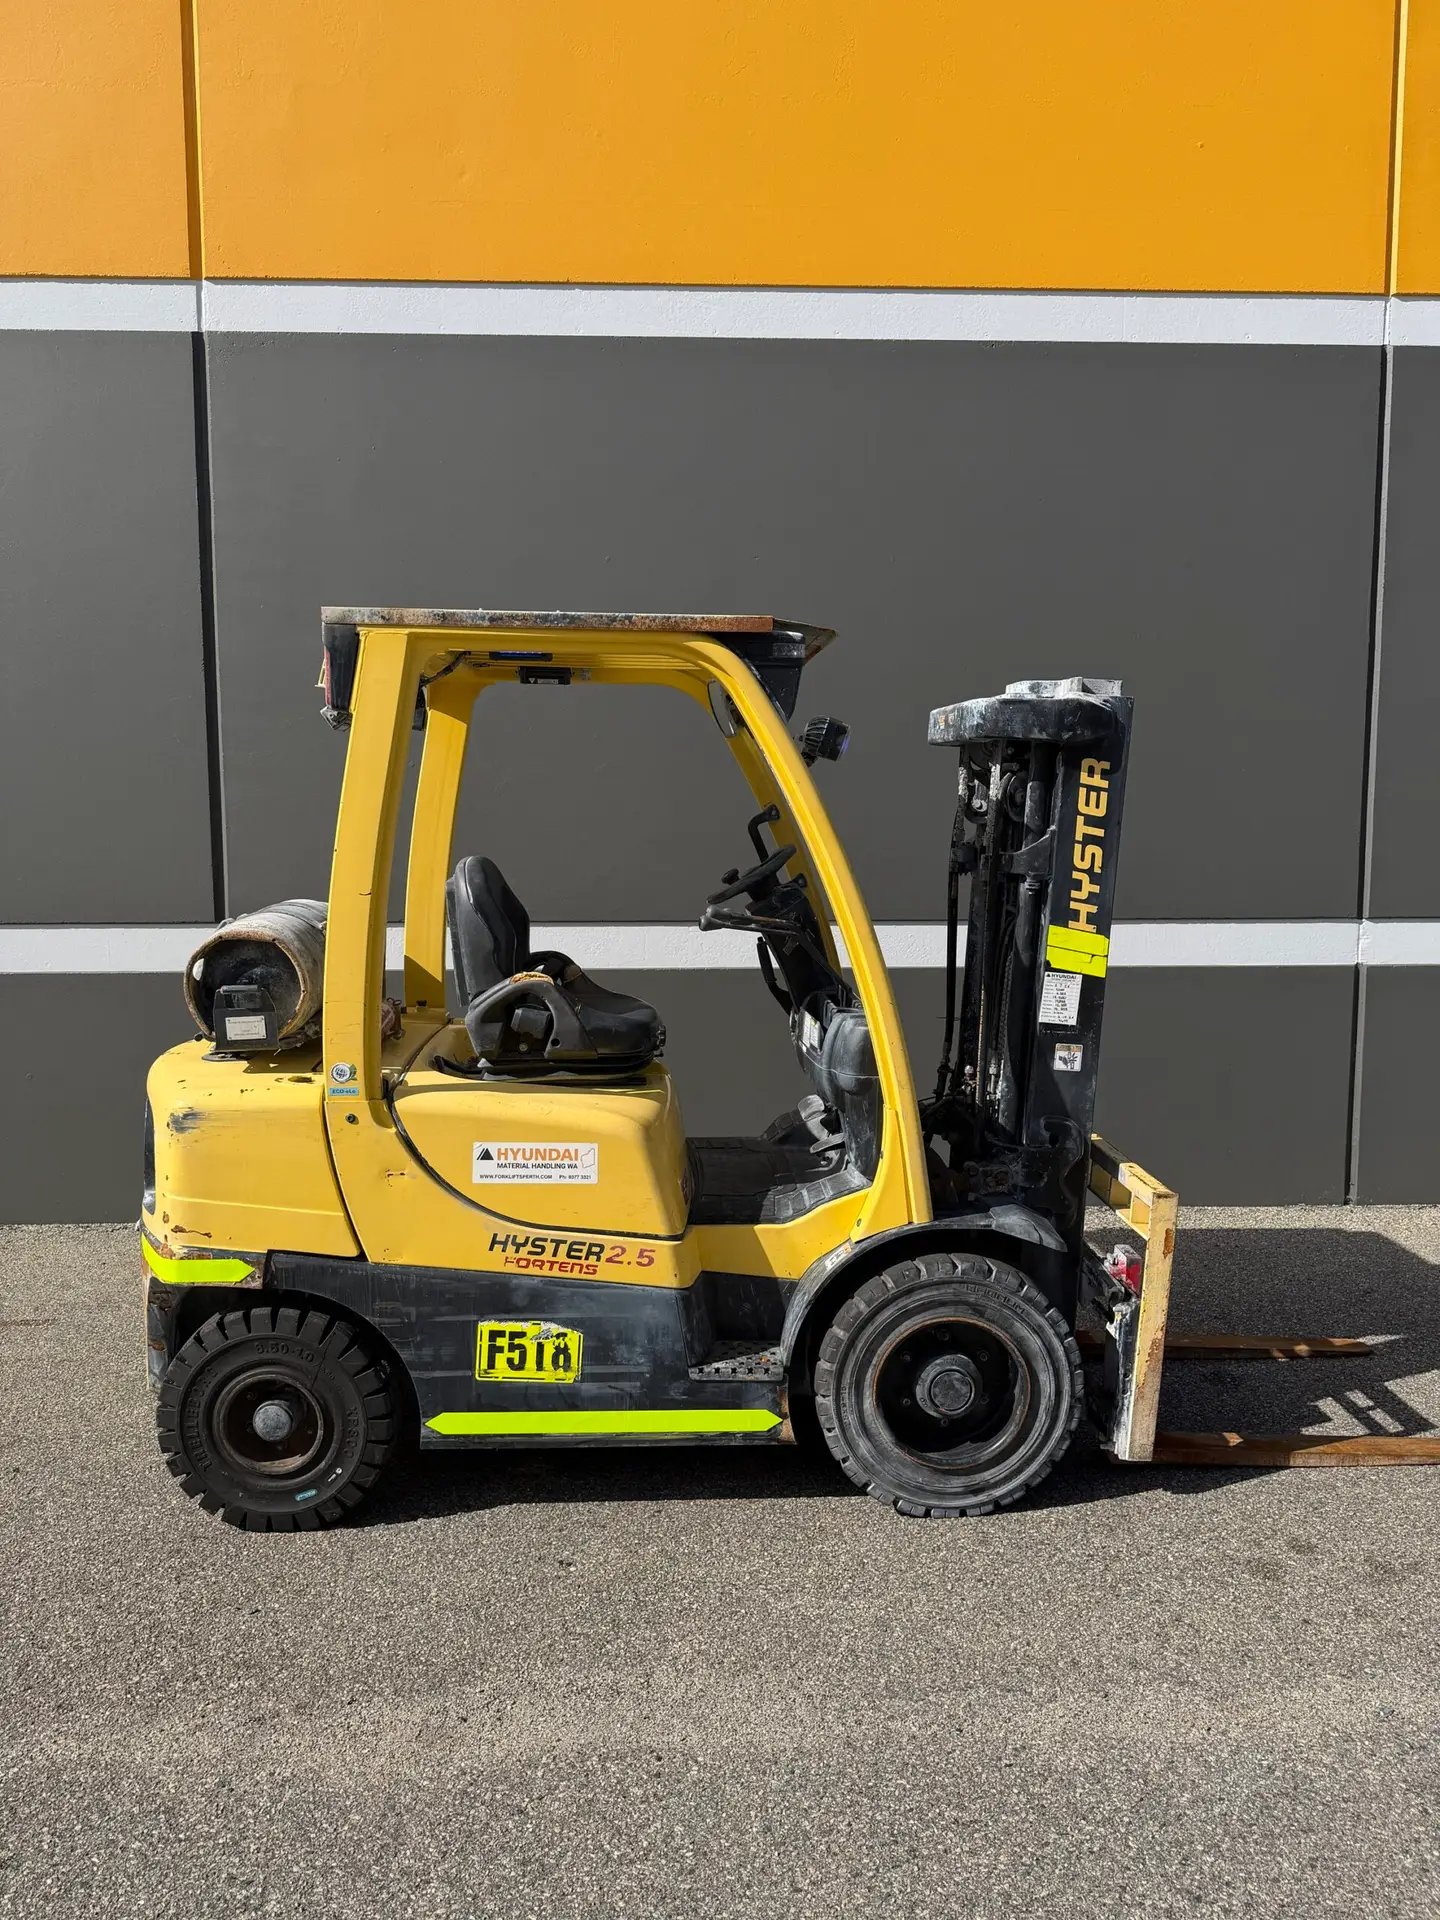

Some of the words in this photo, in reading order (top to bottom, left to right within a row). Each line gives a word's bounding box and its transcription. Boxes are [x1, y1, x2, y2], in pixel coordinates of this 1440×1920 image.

[1068, 757, 1111, 933] HYSTER
[496, 1147, 579, 1161] HYUNDAI
[488, 1233, 605, 1263] HYSTER
[605, 1245, 656, 1267] 2.5
[486, 1329, 572, 1372] F518
